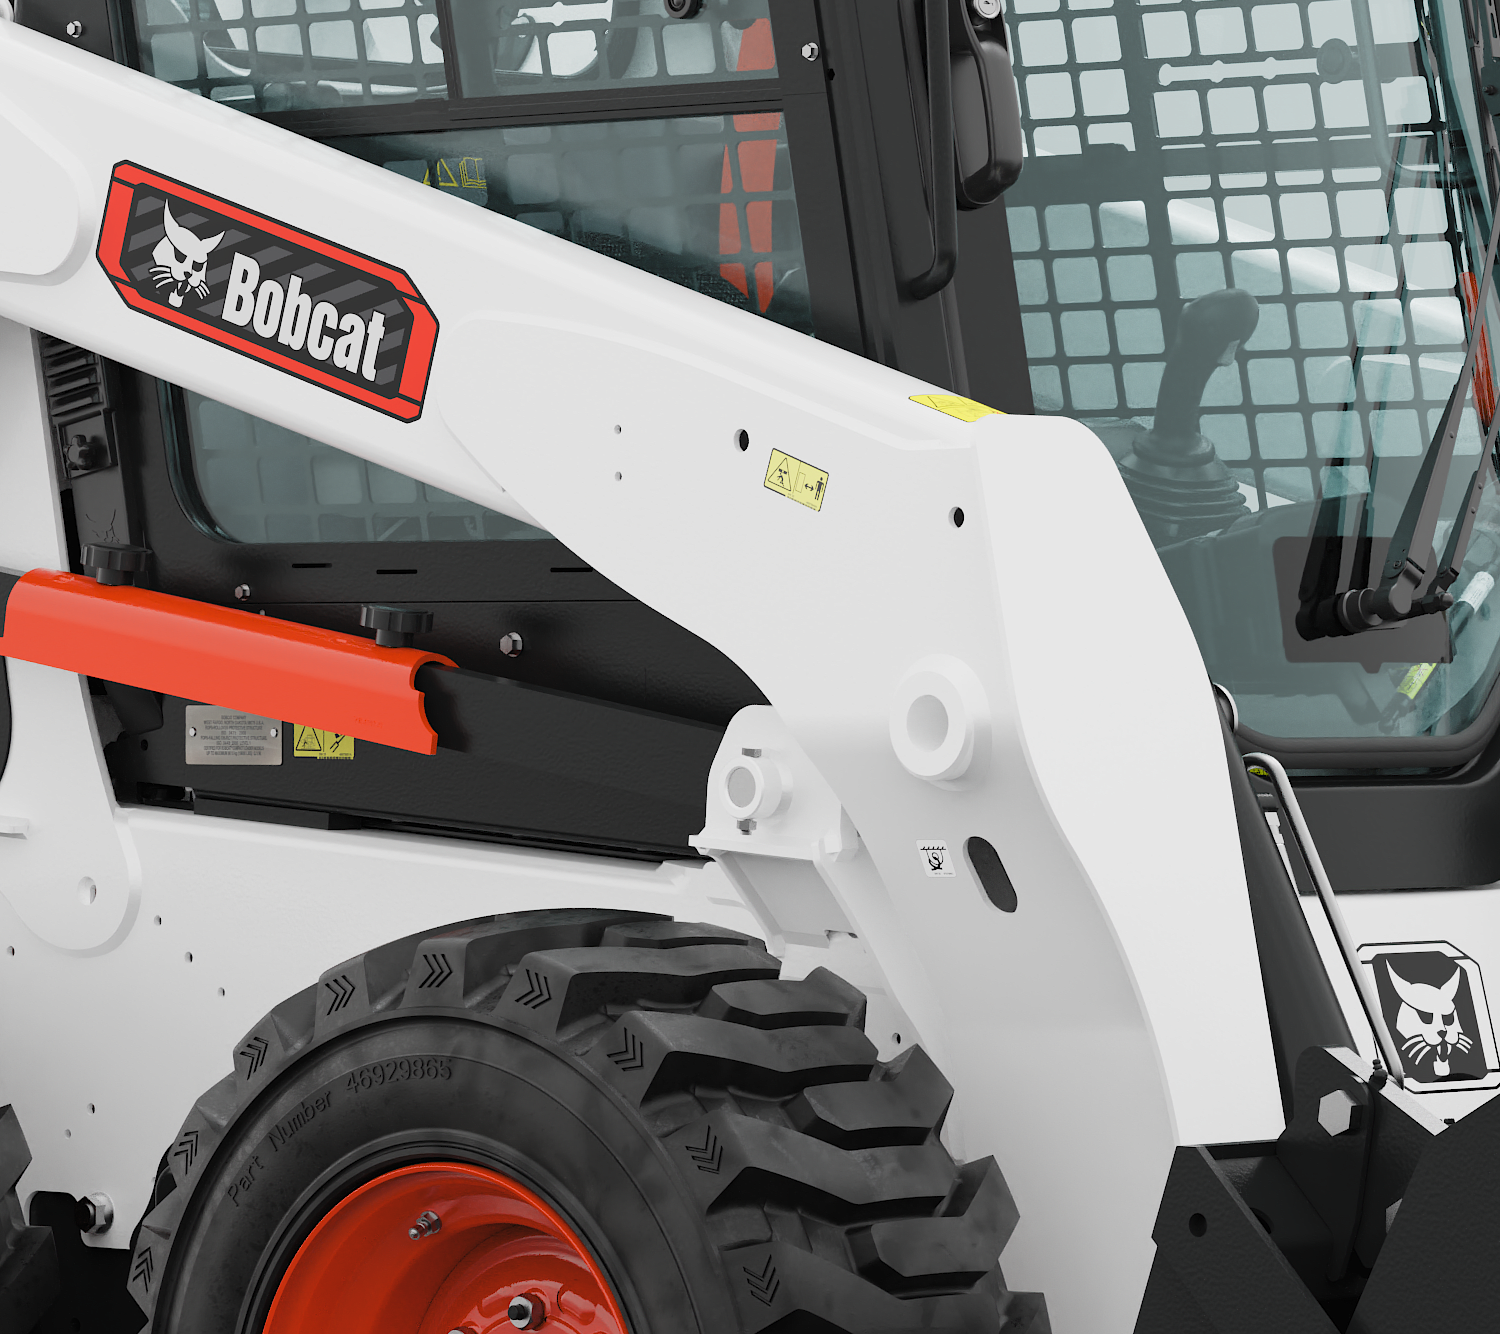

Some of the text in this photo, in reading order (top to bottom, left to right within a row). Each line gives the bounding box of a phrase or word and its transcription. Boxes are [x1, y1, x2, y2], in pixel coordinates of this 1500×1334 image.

[221, 251, 386, 382] Bobcat
[227, 1057, 452, 1207] Part Number 46929865
